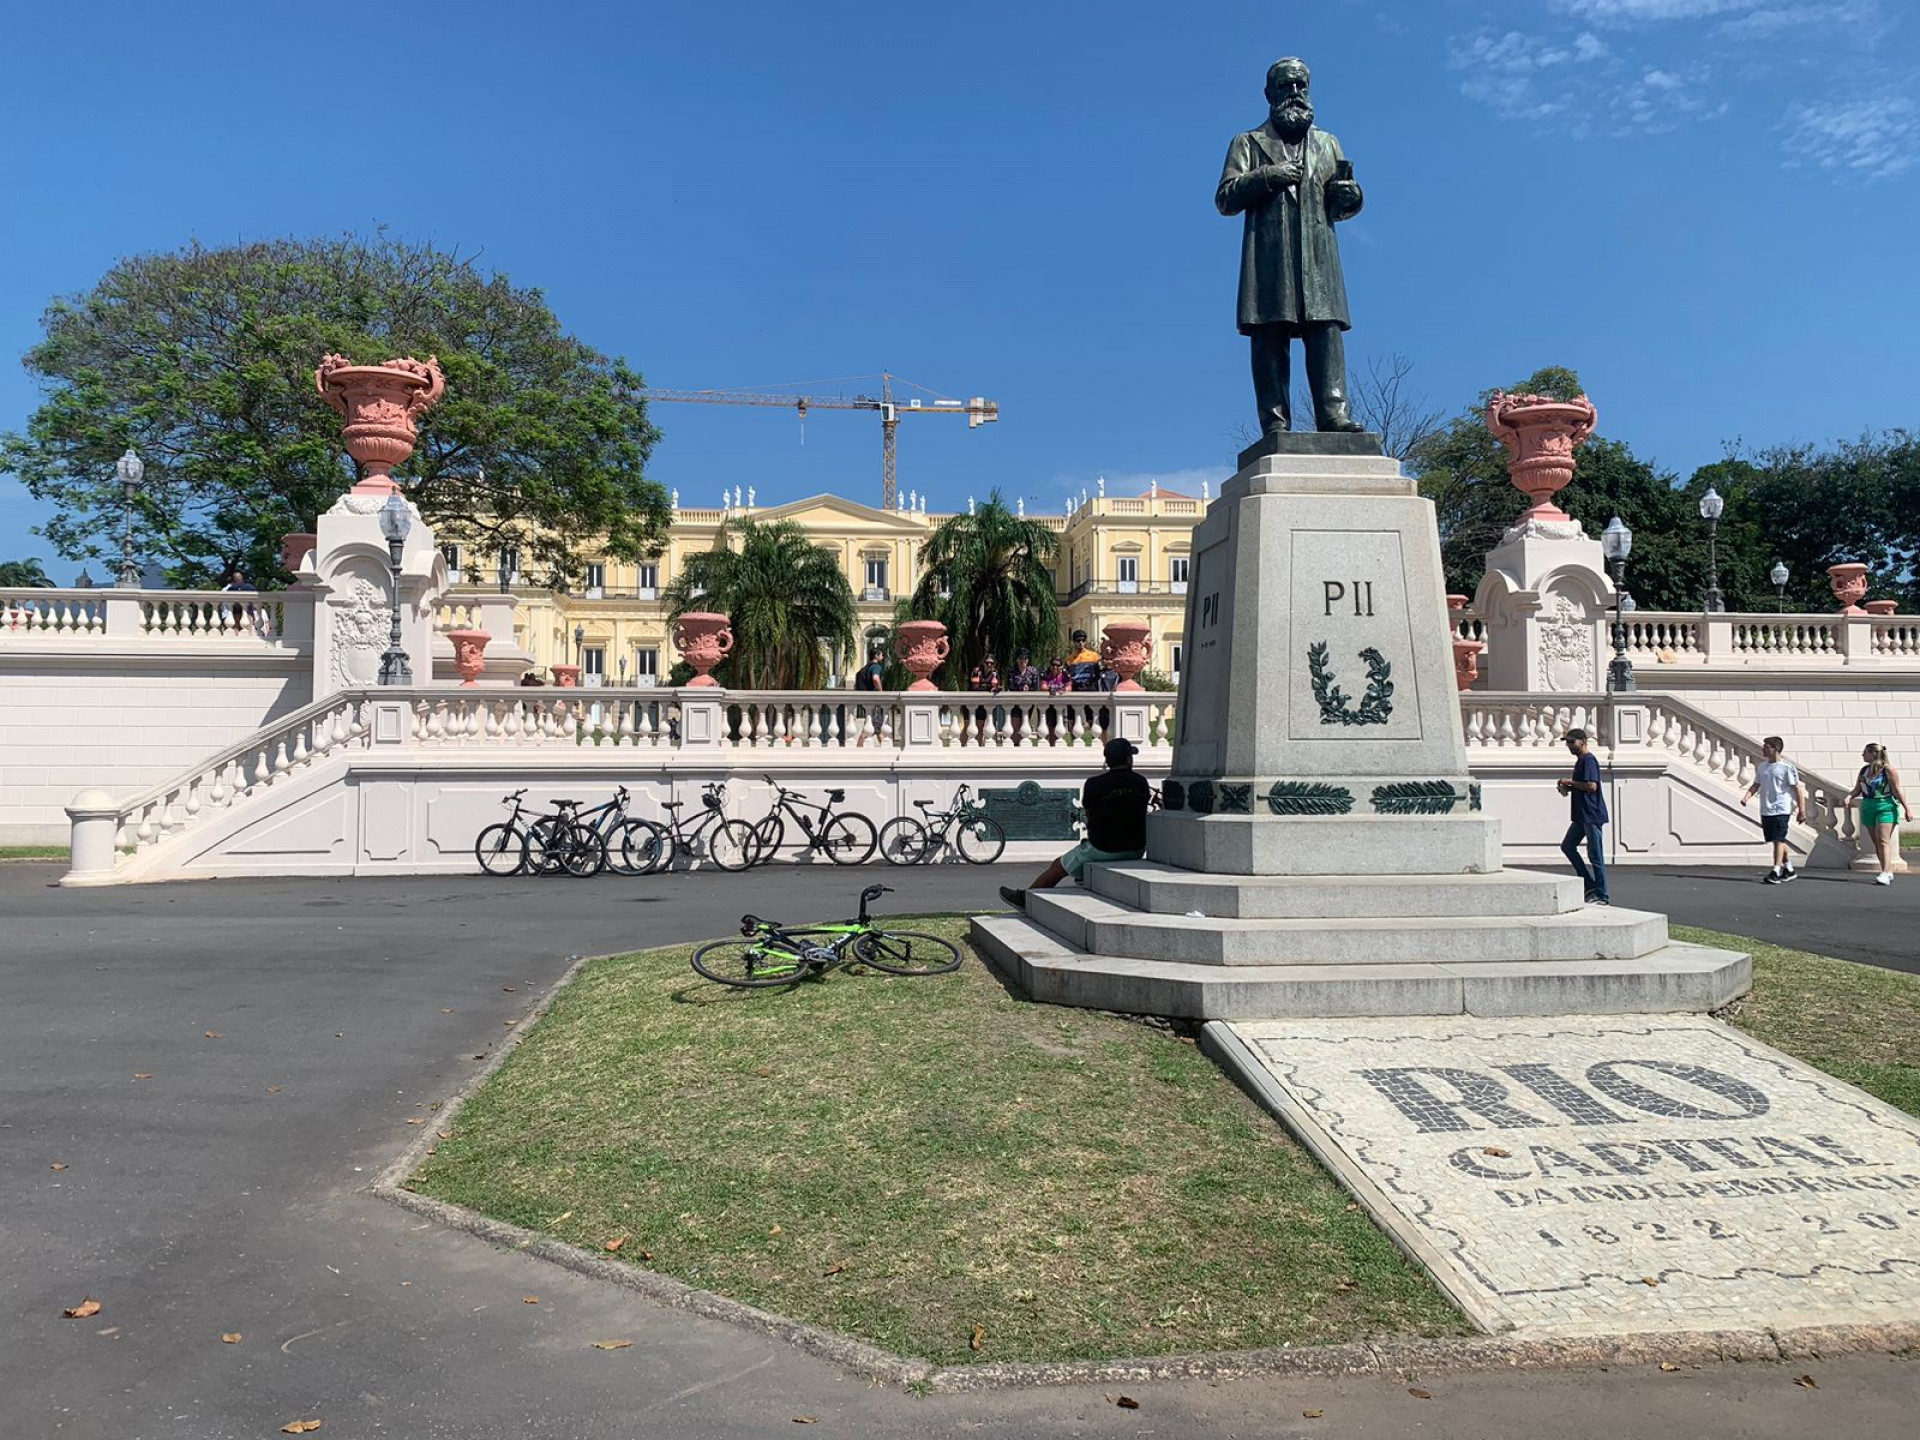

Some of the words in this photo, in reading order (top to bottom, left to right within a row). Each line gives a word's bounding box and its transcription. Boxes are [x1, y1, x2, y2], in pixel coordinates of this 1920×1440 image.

[1350, 1060, 1770, 1134] RIO
[1448, 1135, 1894, 1181] CAPITAL
[1495, 1188, 1568, 1208] DA
